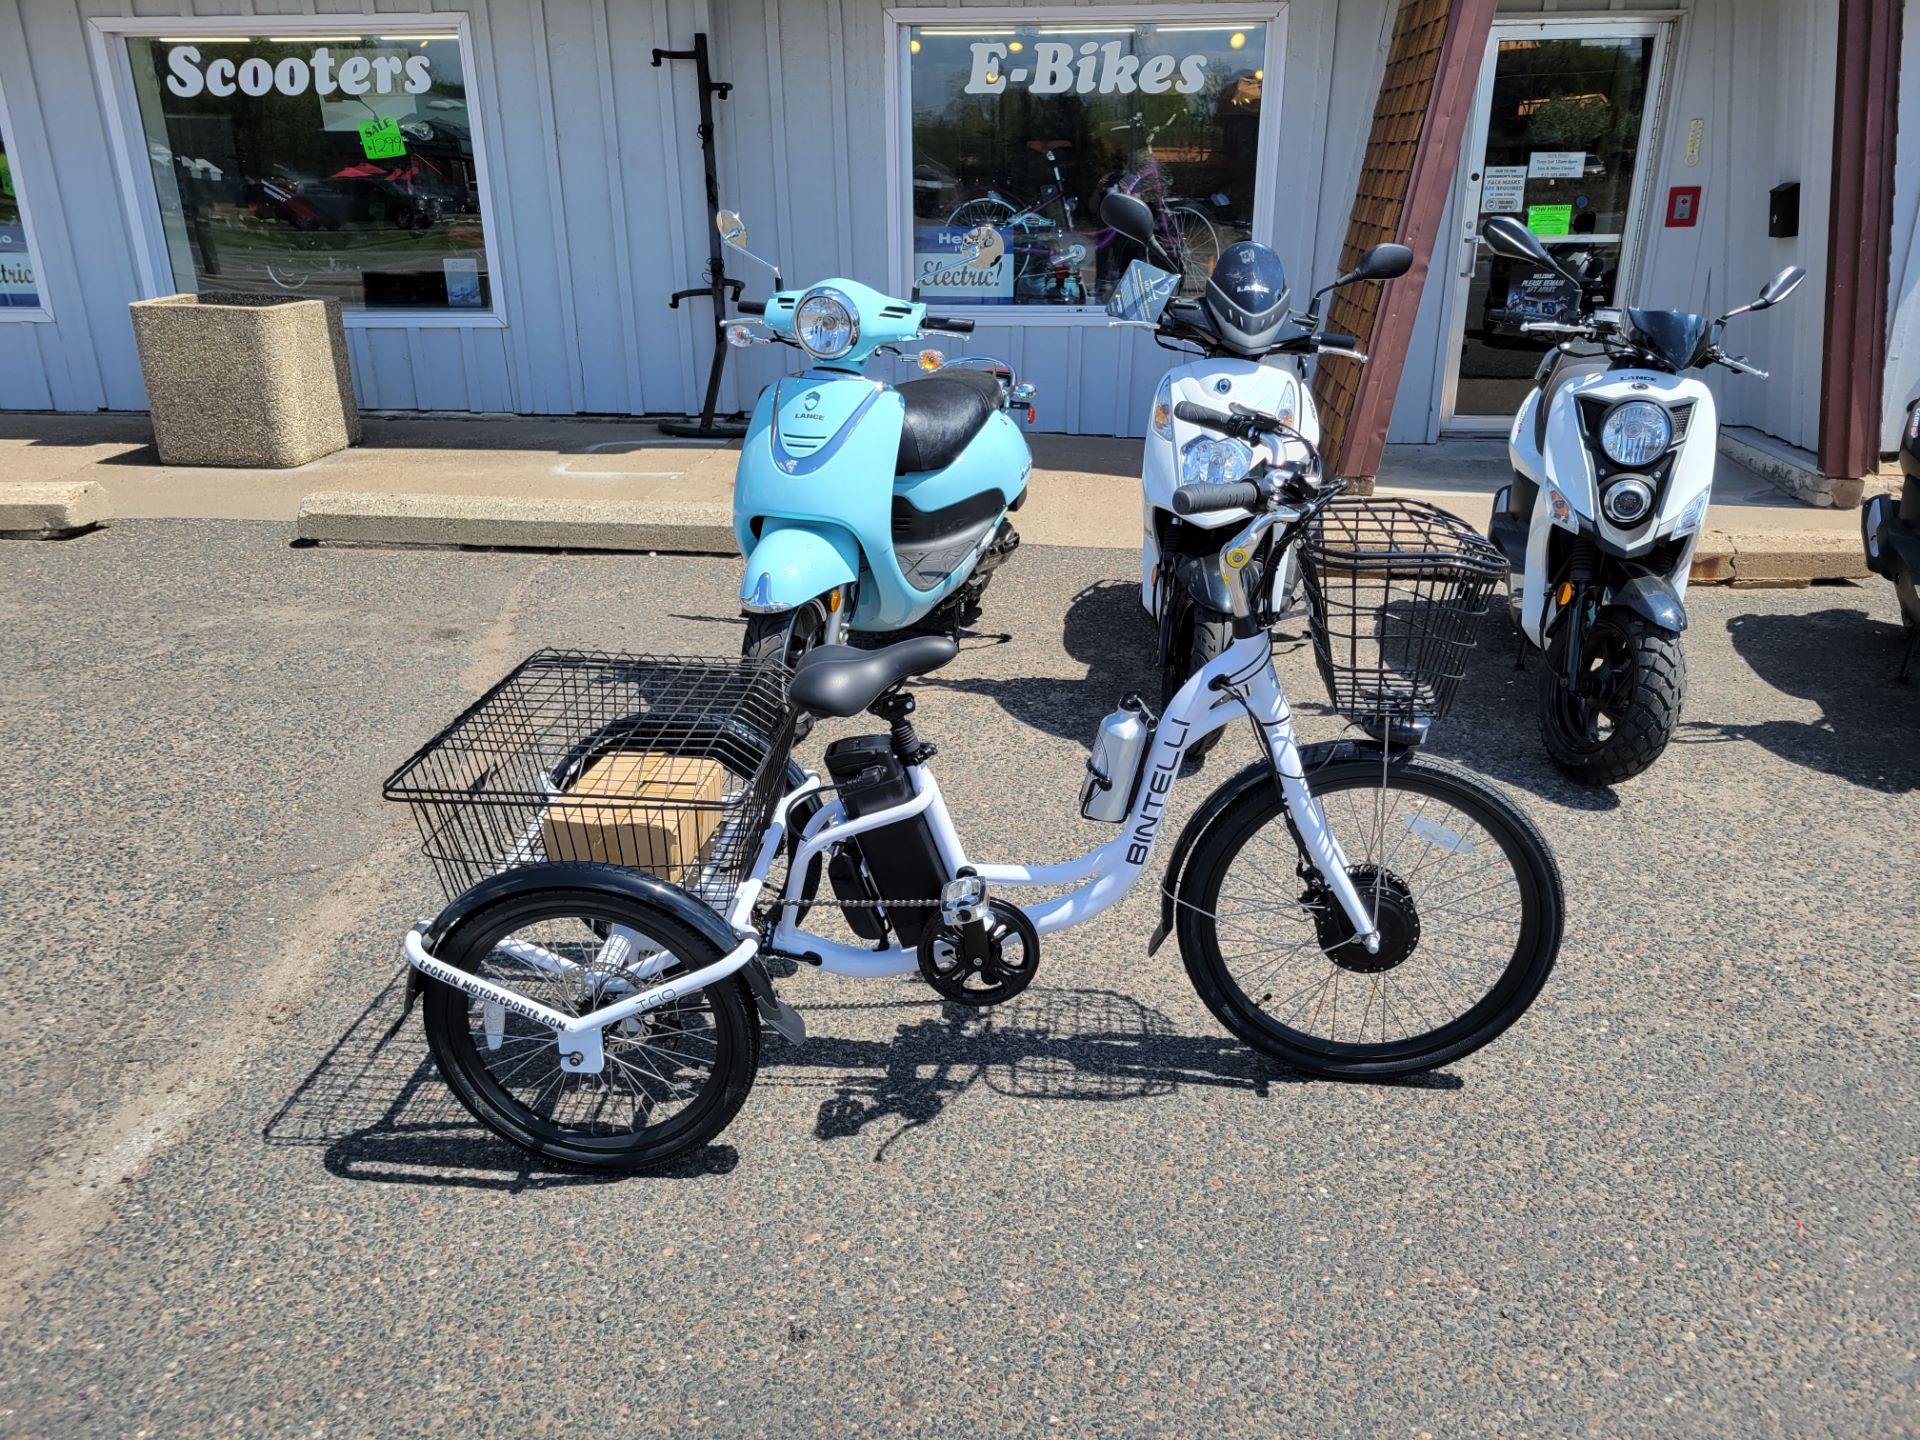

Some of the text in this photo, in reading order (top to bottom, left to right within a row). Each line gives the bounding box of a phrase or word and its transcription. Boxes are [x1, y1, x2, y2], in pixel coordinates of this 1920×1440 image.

[166, 46, 432, 97] Scooters
[964, 41, 1207, 94] E-Bikes
[364, 117, 392, 137] SALE
[920, 260, 1003, 288] Electric!
[1521, 279, 1566, 287] PLEASE REMAIN
[1619, 375, 1658, 383] LANCE
[794, 412, 826, 421] LANCE
[1125, 717, 1191, 866] BINTELLI
[418, 959, 567, 1032] ECOFUN MOTORSPORTS.COM
